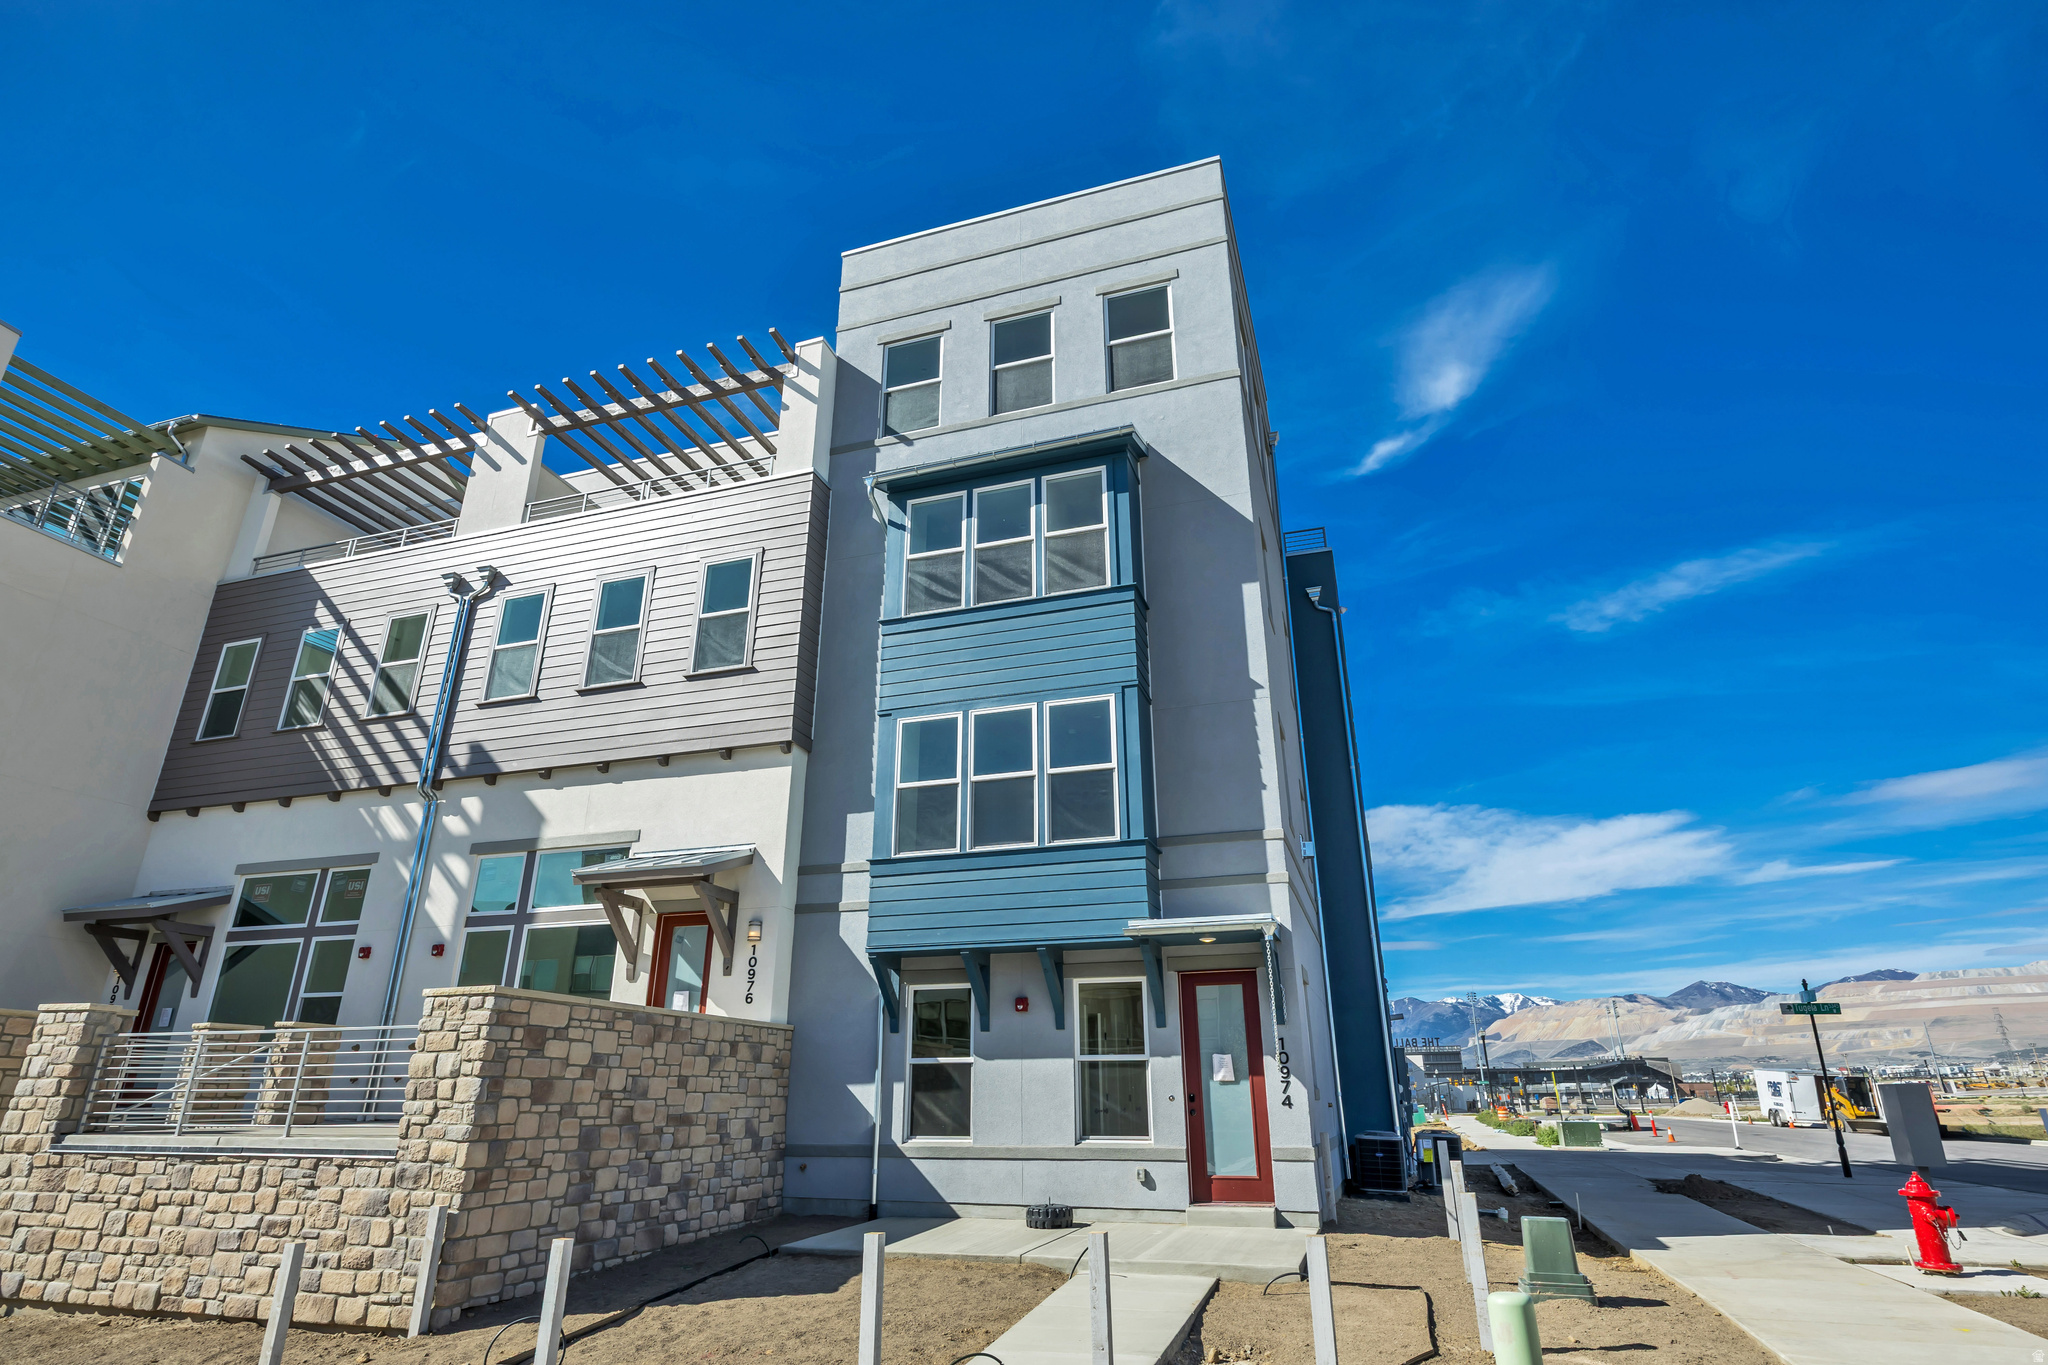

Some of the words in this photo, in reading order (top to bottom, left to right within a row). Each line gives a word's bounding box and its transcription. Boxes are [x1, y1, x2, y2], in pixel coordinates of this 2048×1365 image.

[255, 885, 270, 896] USI
[348, 880, 365, 891] USI
[745, 944, 757, 1004] 10976
[109, 976, 120, 1005] 109
[1795, 1004, 1817, 1013] Tugela
[1278, 1037, 1293, 1109] 10974
